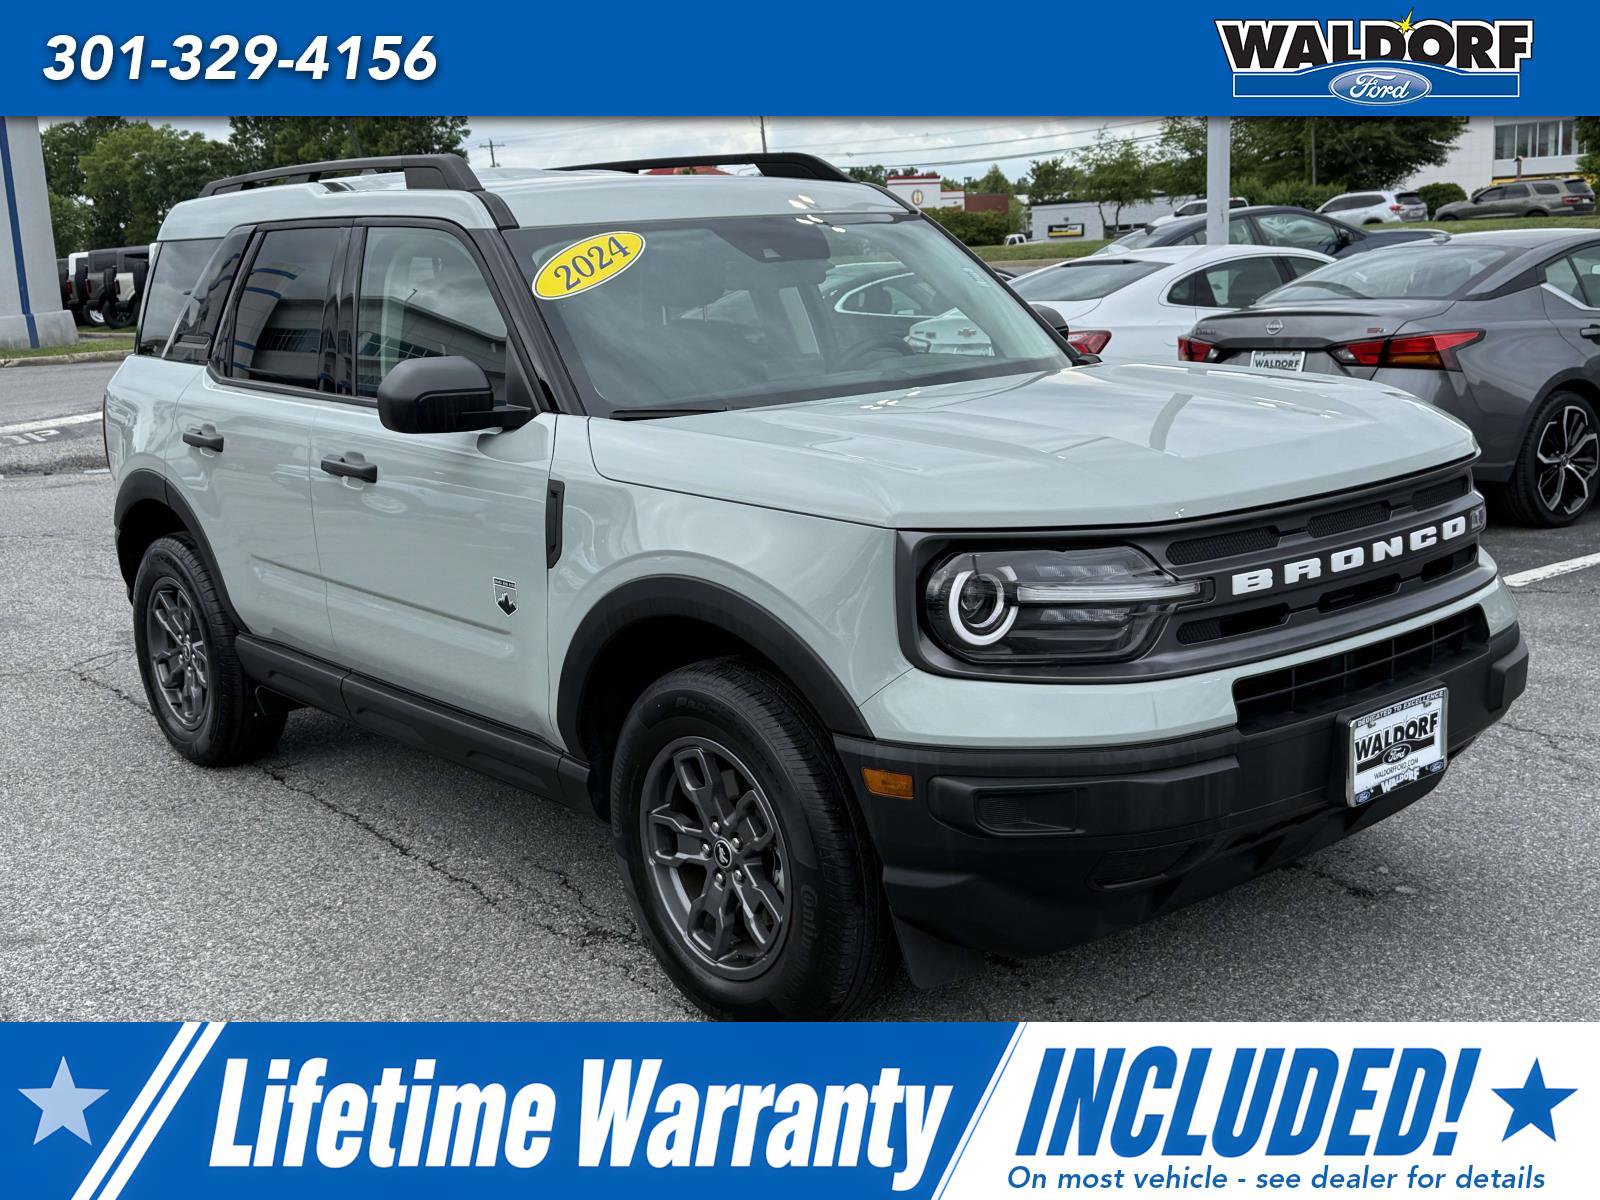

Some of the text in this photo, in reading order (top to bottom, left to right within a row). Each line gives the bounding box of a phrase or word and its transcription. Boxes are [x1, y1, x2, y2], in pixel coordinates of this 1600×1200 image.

[553, 235, 631, 291] 2024
[1254, 358, 1300, 369] WALDORF
[1231, 515, 1467, 596] BRONCO
[1357, 690, 1445, 727] DEDICATED TO EXCELLENCE
[1355, 711, 1439, 762] WALDORF
[1373, 757, 1419, 780] WALDORFFORD.COM
[1388, 747, 1406, 762] Ford
[1380, 766, 1421, 793] WALDORF
